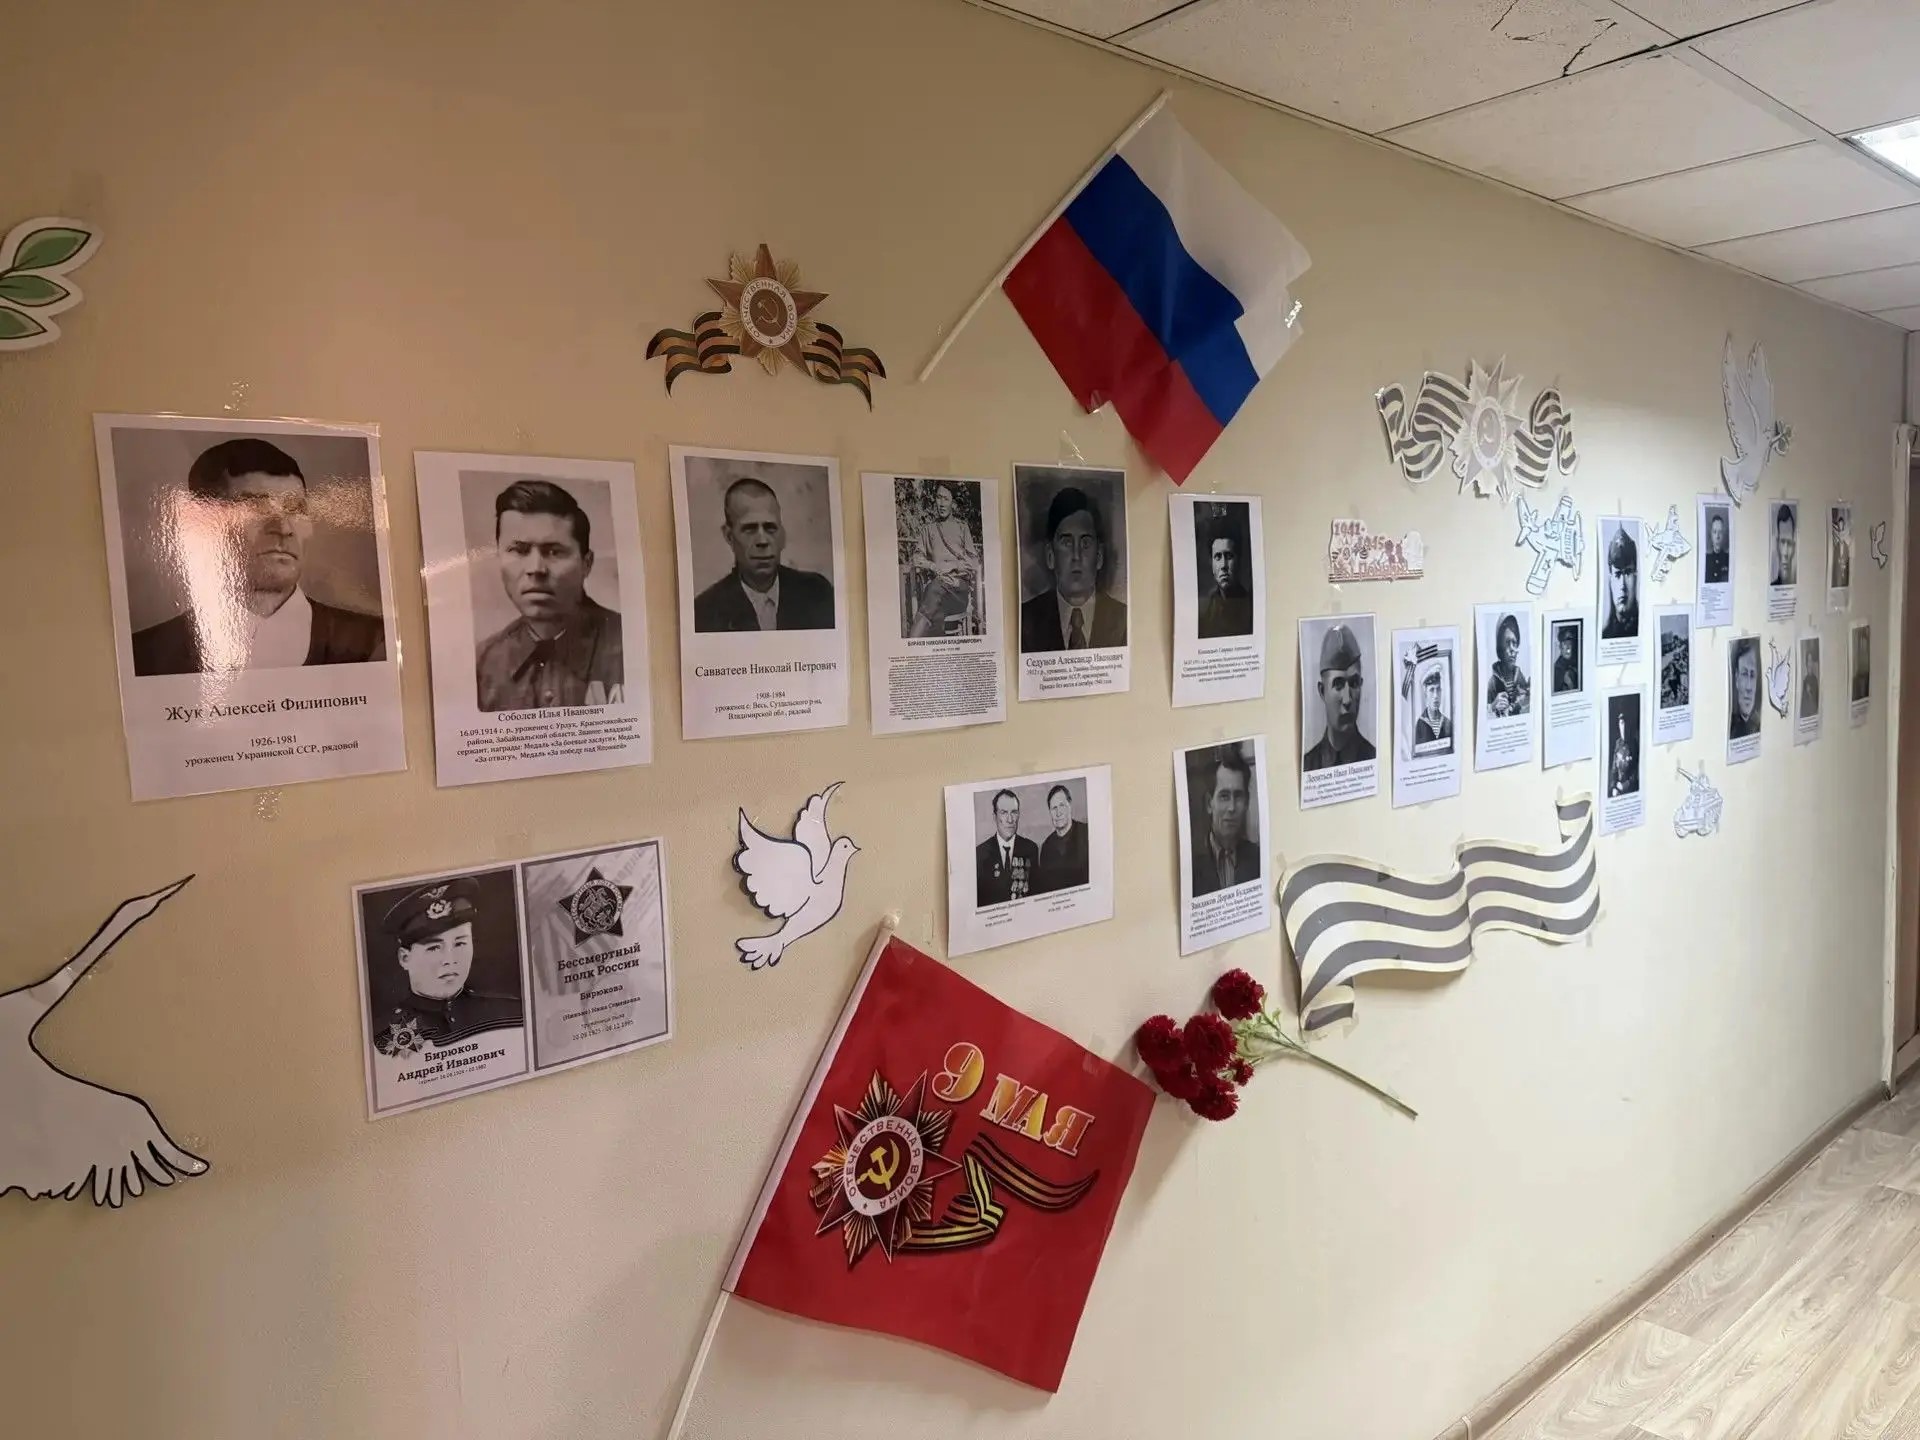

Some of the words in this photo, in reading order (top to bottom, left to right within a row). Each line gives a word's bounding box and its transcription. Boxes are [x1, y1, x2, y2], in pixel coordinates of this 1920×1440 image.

[695, 665, 748, 677] Савватеев
[750, 663, 792, 674] Николай
[794, 661, 837, 674] Петрович
[165, 706, 203, 724] Жук
[209, 699, 276, 718] Алексей
[281, 694, 368, 713] Филипович
[497, 711, 537, 722] Соболев
[539, 709, 561, 720] Илья
[563, 706, 605, 717] Иванович
[184, 753, 235, 768] уроженец
[236, 746, 294, 762] Украинской
[322, 740, 360, 754] рядовой
[250, 734, 298, 748] 1926-1981
[520, 751, 546, 760] Медаль
[557, 942, 641, 971] Бессмертный
[564, 968, 594, 984] полк
[597, 957, 640, 977] России
[579, 984, 624, 1001] Бирюкова
[397, 1063, 444, 1083] Андрей
[446, 1048, 506, 1071] Иванович
[424, 1042, 479, 1062] Бирюков
[931, 1041, 985, 1102] 9
[979, 1072, 1096, 1157] МАЯ
[846, 1119, 921, 1197] ОТЕЧЕСТВЕННАЯ
